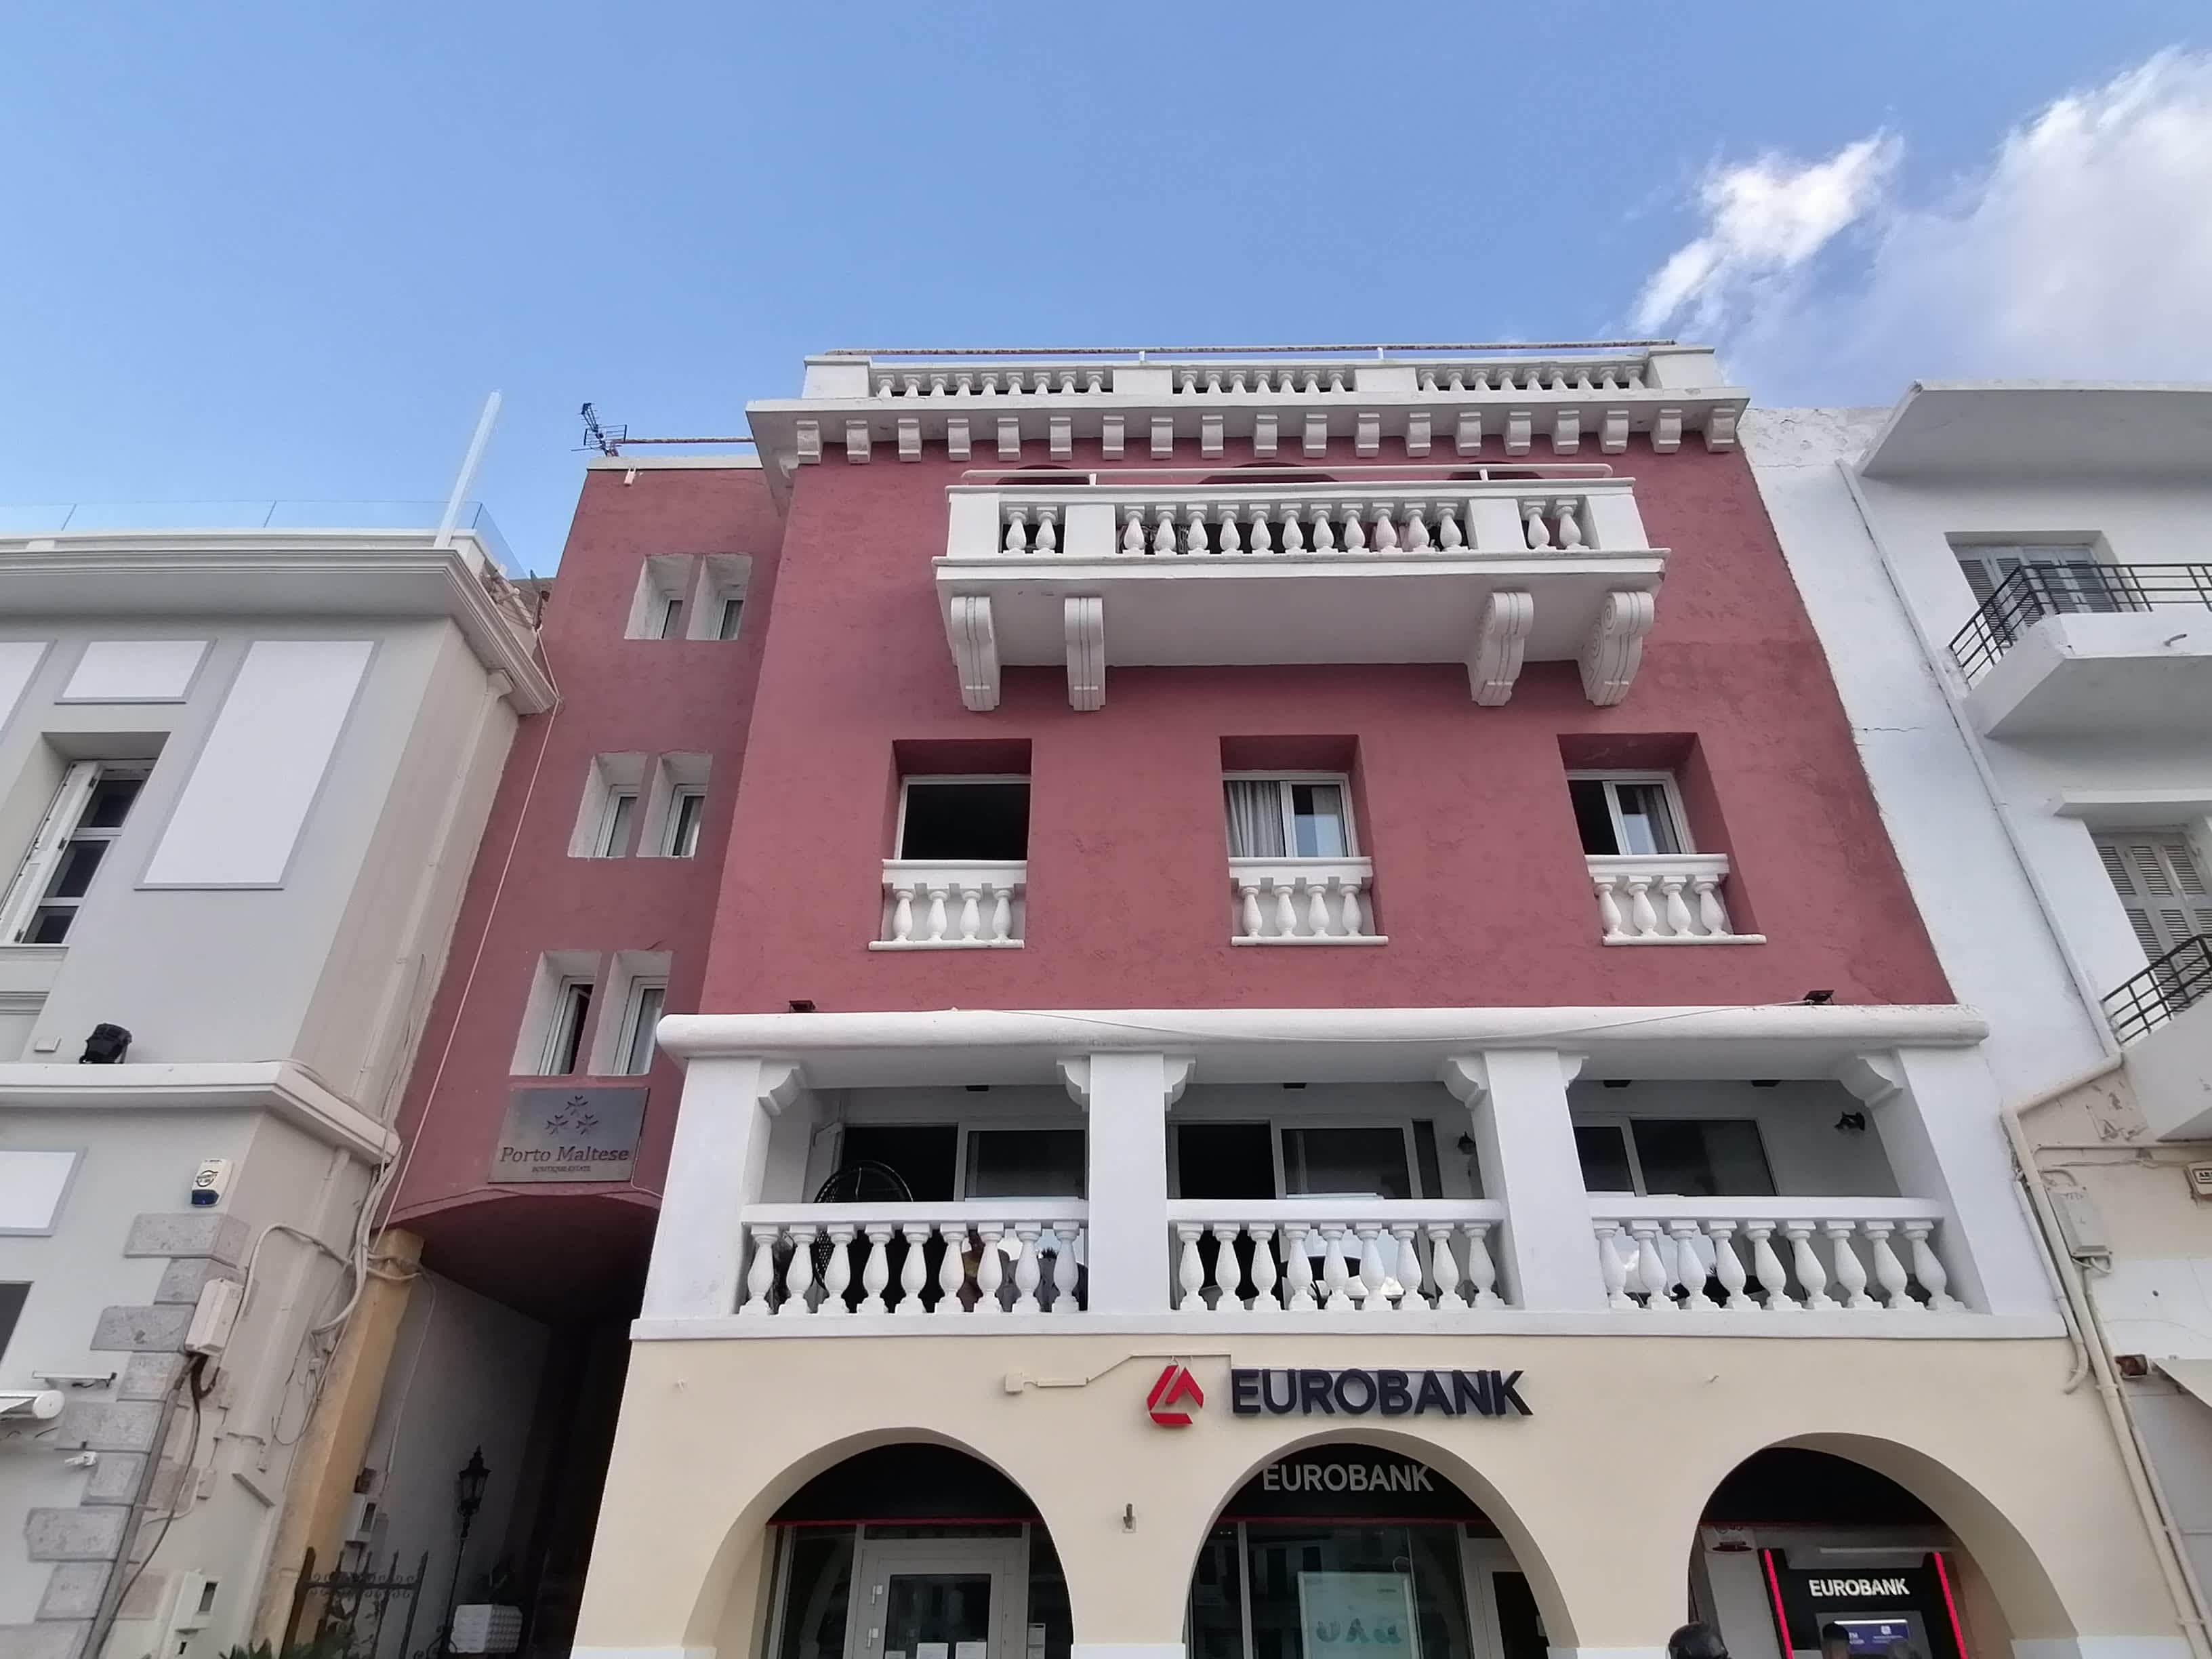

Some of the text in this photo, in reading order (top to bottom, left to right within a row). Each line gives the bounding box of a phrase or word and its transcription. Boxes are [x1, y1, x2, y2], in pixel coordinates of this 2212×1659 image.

[499, 1146, 630, 1162] Porto Maltese
[1231, 1368, 1534, 1416] EUROBANK
[1263, 1464, 1434, 1491] EUROBANK
[1809, 1578, 1910, 1597] EUROBANK
